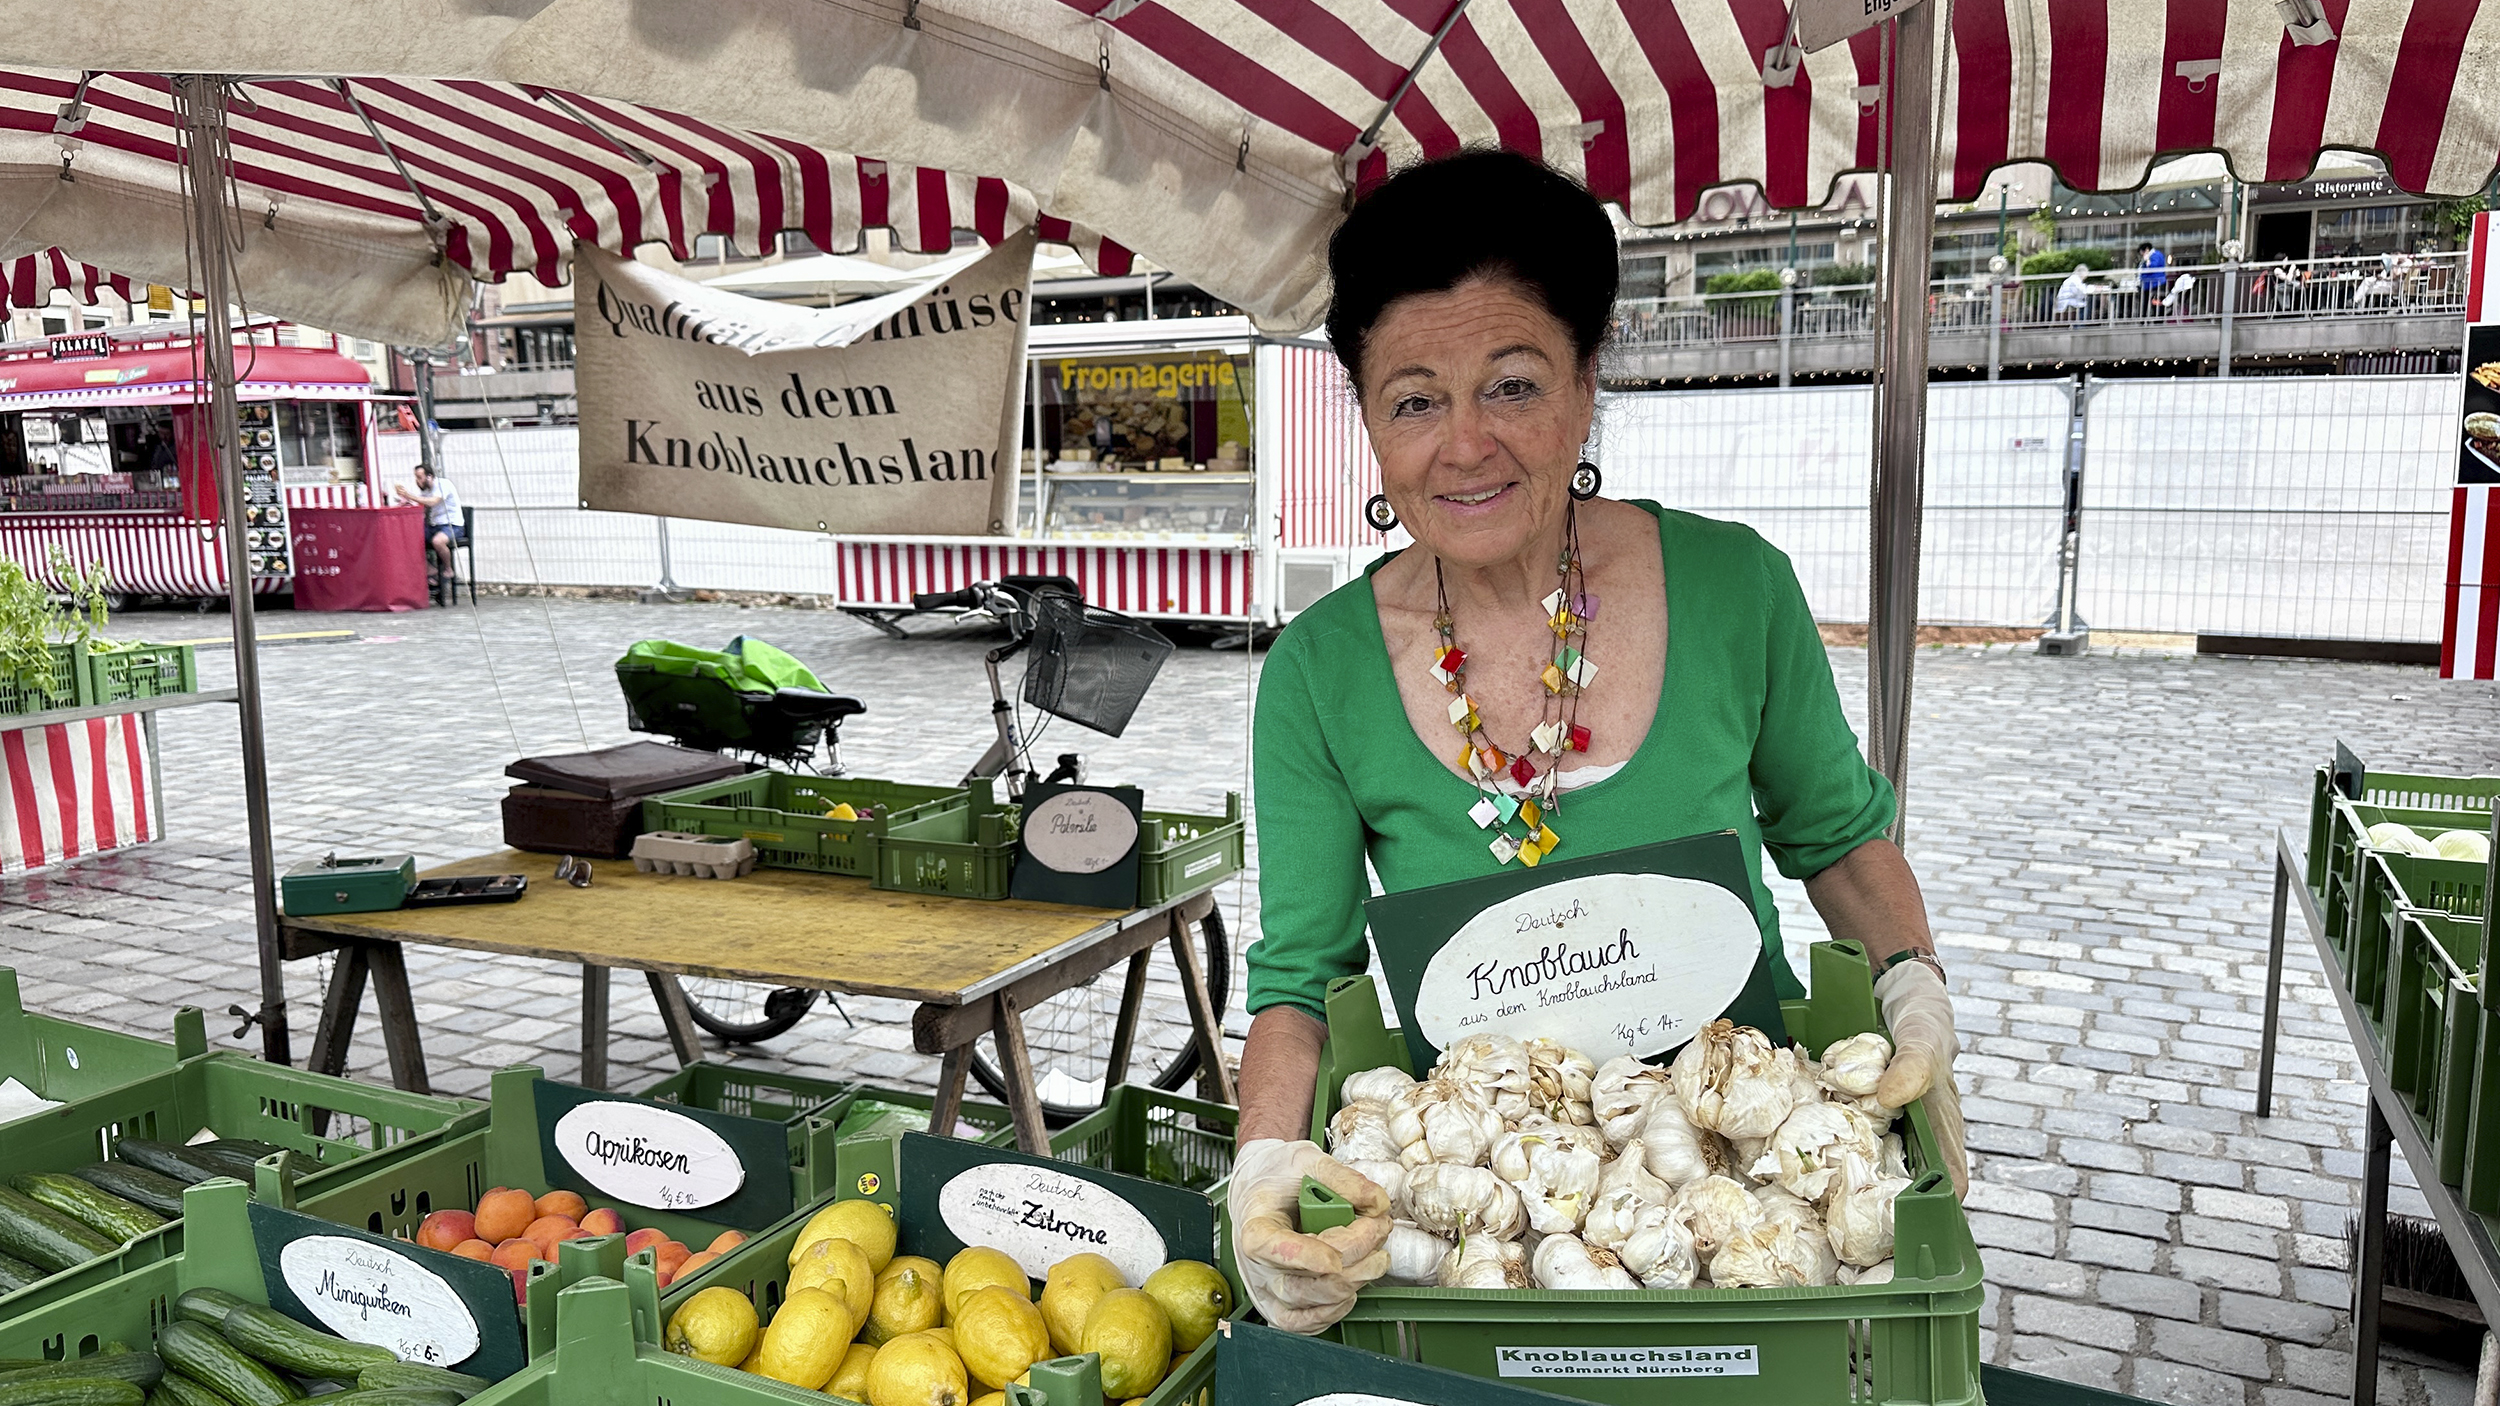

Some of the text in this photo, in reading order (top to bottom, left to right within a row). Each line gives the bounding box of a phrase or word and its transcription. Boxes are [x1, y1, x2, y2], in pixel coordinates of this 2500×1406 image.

[2314, 179, 2383, 194] Ristorante
[52, 337, 106, 356] FALAFEL
[1060, 355, 1234, 398] Fromagerie
[694, 372, 899, 418] aus dem
[1515, 899, 1589, 934] Deutsch
[1466, 928, 1640, 1000] Knoblauch
[1458, 963, 1658, 1028] aus dem Knoblauchsland
[1026, 1173, 1085, 1201] Deutsch
[1020, 1200, 1107, 1245] Zitrone
[345, 1247, 395, 1277] Deutsch
[315, 1269, 412, 1321] Minigurken
[1502, 1349, 1751, 1362] Knoblauchsland
[1531, 1365, 1724, 1374] Großmarkt Nürnberg
